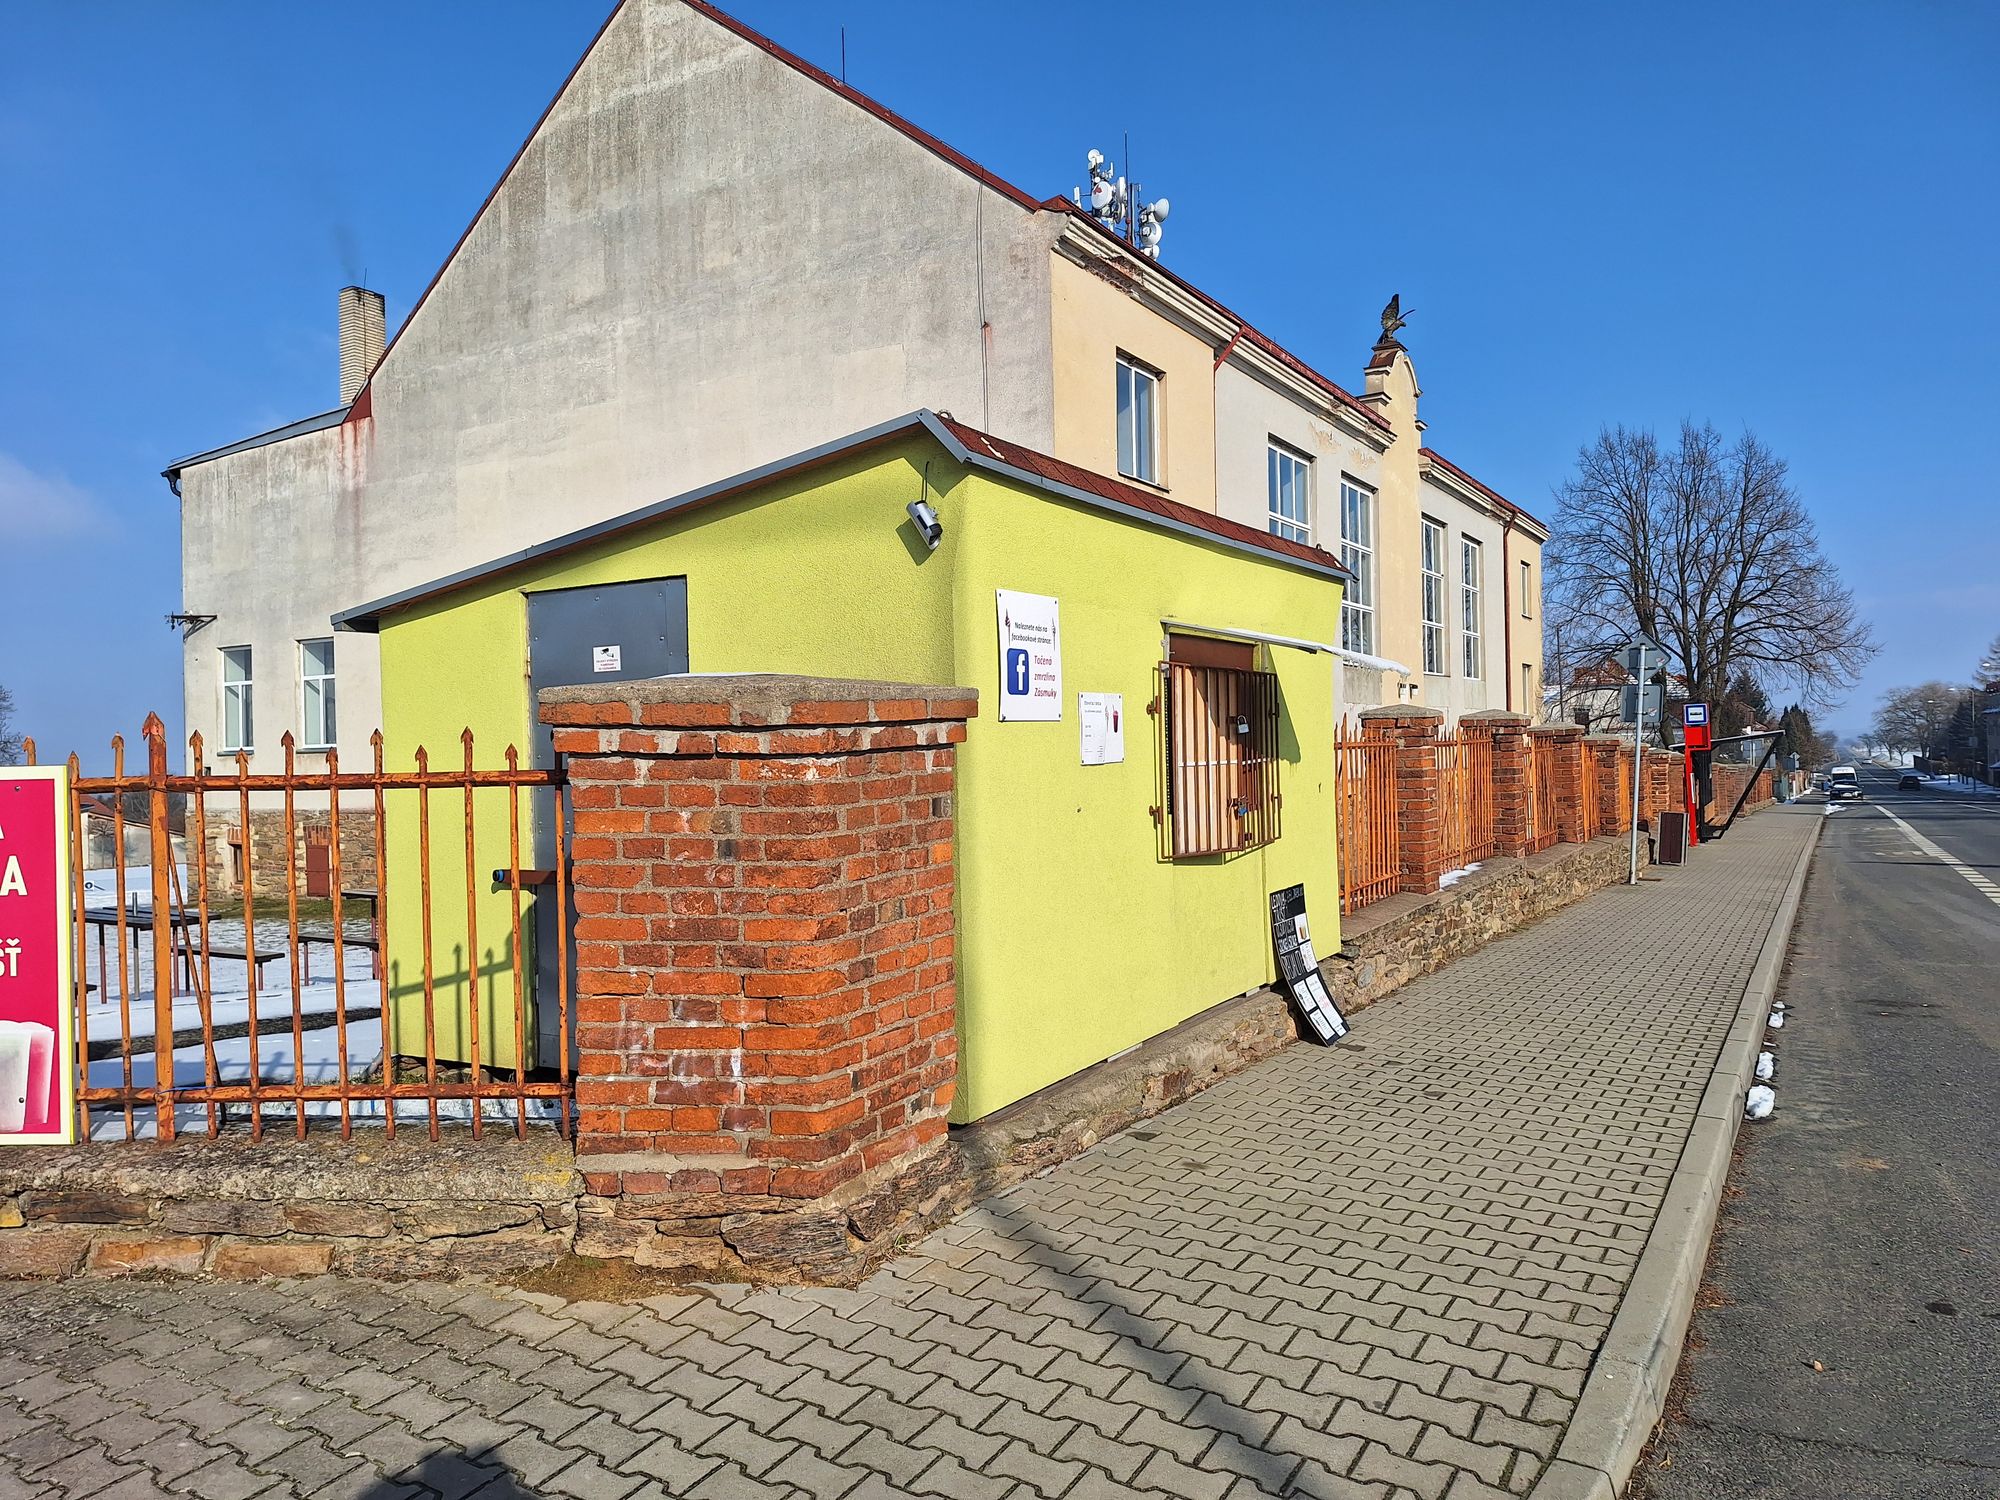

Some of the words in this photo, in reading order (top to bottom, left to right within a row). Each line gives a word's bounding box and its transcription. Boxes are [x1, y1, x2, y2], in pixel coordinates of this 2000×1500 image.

[1014, 621, 1034, 631] Naleznete
[1011, 632, 1037, 643] facebookové
[1034, 655, 1052, 666] Točená
[1034, 672, 1056, 681] zmrzlina
[1034, 687, 1057, 699] Zásmuky
